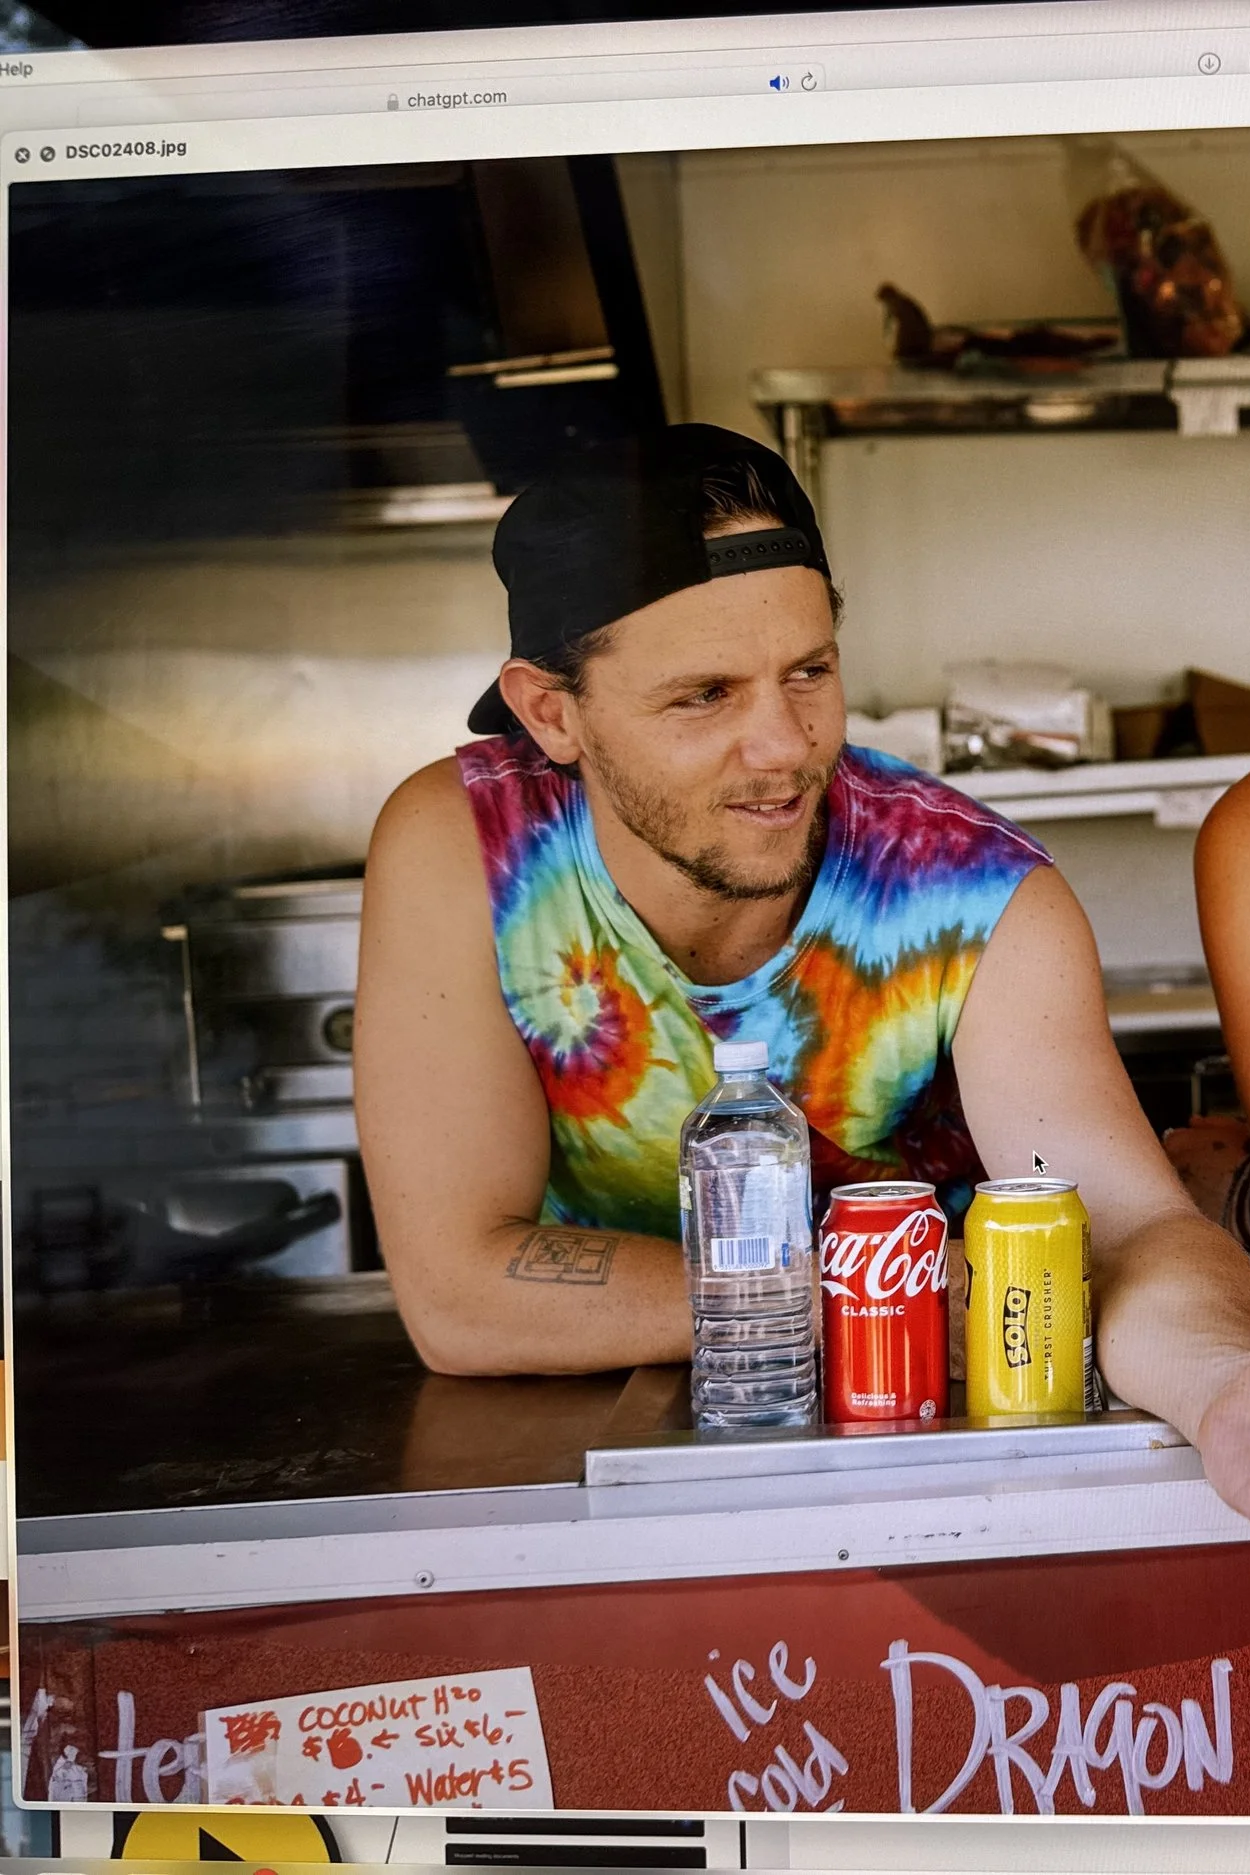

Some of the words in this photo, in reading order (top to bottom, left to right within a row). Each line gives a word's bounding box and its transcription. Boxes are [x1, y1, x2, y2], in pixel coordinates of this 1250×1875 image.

[0, 62, 33, 78] Help
[407, 92, 507, 109] chatgpt.com
[66, 140, 187, 159] DSC02408.jpg
[841, 1305, 905, 1317] CLASSIC
[1043, 1270, 1053, 1329] CRUSHER
[1004, 1289, 1028, 1364] SOLO
[851, 1392, 888, 1400] Delicious
[852, 1399, 897, 1408] Refreshing
[704, 1640, 818, 1743] ice
[298, 1694, 428, 1733] COCONUT
[728, 1720, 849, 1813] cold
[404, 1762, 487, 1805] Water
